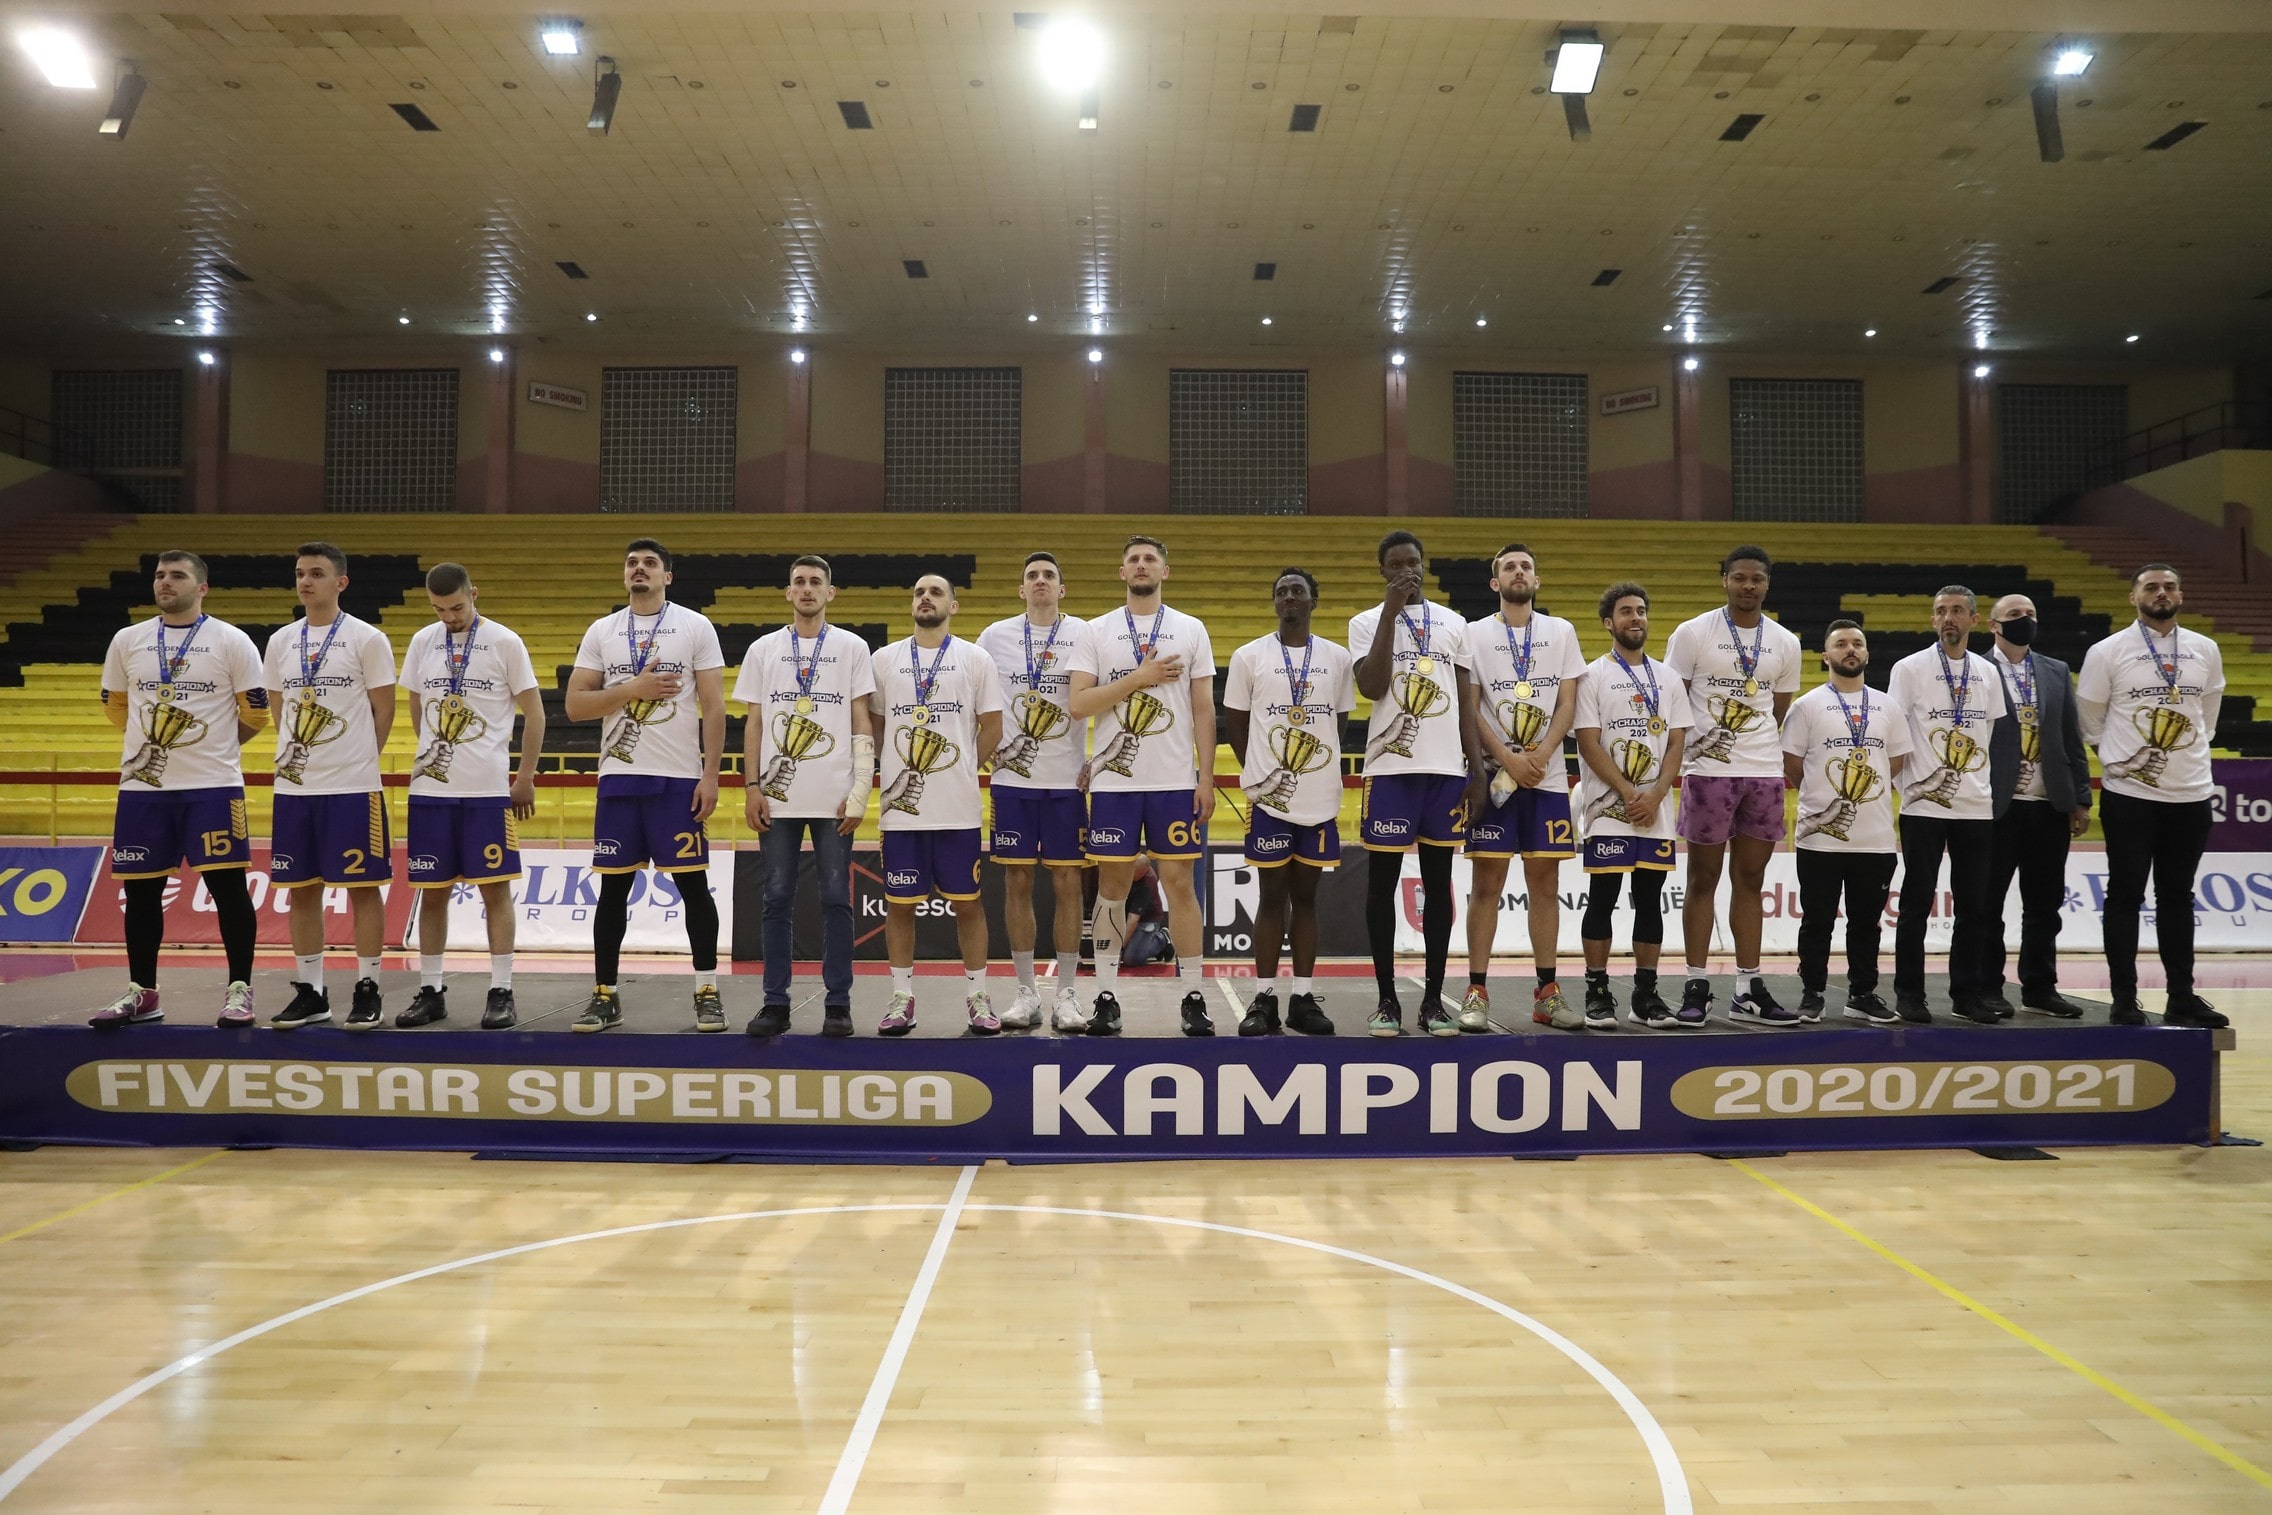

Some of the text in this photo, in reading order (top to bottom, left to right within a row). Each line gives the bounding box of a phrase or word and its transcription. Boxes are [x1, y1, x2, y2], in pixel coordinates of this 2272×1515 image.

[1039, 685, 1057, 694] 021
[1091, 829, 1121, 844] Relax
[1373, 820, 1408, 835] Relax
[1545, 819, 1573, 844] 12
[201, 830, 232, 857] 15
[673, 831, 702, 859] 21
[1257, 837, 1290, 851] Relax
[1317, 829, 1326, 853] 1
[1597, 843, 1625, 856] Relax
[342, 849, 366, 875] 2
[483, 844, 504, 869] 9
[887, 870, 919, 886] Relax
[97, 1063, 953, 1120] FIVESTAR SUPERLIGA
[1032, 1060, 1643, 1136] KAMPION
[1713, 1063, 2136, 1114] 2020/2021
